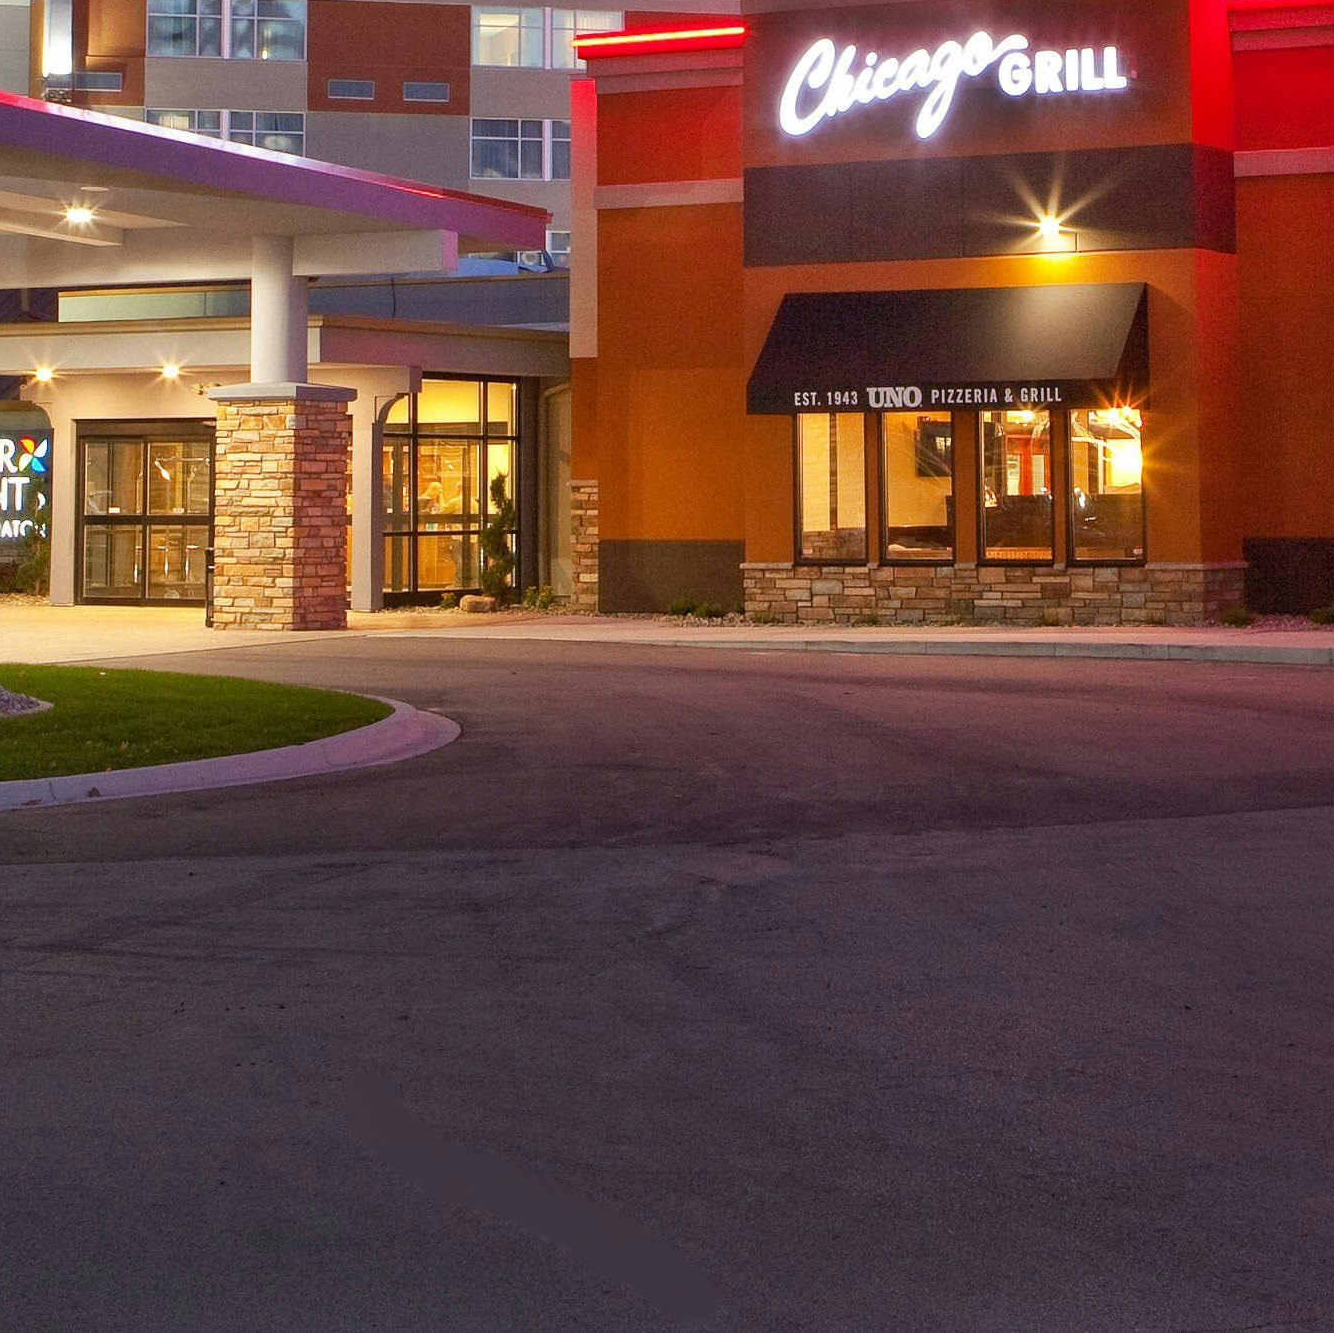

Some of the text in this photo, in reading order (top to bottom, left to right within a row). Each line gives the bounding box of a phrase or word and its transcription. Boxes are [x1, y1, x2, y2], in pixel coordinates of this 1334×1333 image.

[779, 31, 1128, 139] Chicago GRILL
[794, 386, 1062, 408] EST. 1943 UNO PIZZERIA & GRILL
